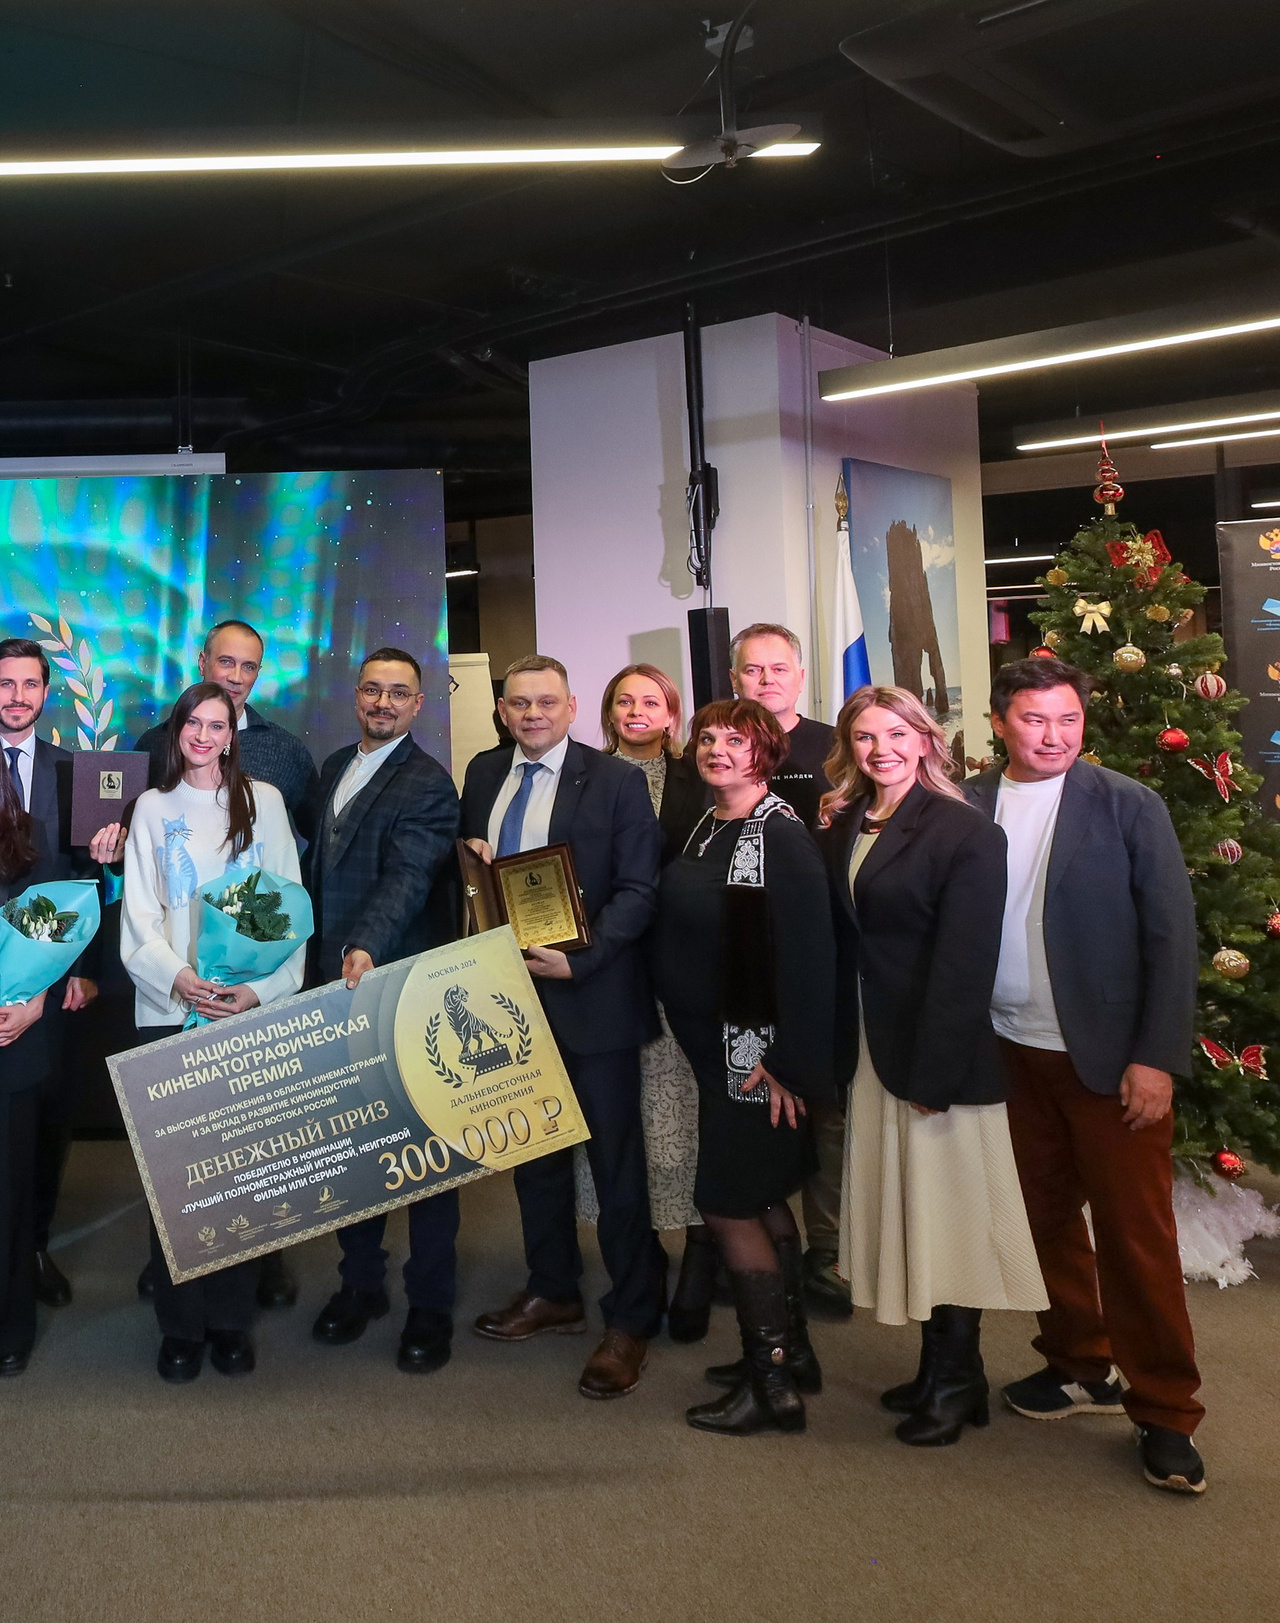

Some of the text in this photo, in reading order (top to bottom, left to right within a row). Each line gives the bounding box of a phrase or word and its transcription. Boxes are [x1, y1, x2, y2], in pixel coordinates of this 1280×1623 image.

[427, 958, 477, 980] МОСКВА 2024
[147, 1014, 370, 1101] КИНЕМАТОГРАФИЧЕСКАЯ
[181, 1009, 325, 1069] НАЦИОНАЛЬНАЯ
[154, 1053, 387, 1138] ЗА ВЫСОКИЕ ДОСТИЖЕНИЯ В ОБЛАСТИ КИНЕМАТОГРАФИИ
[228, 1057, 303, 1095] ПРЕМИЯ
[450, 1069, 542, 1109] ДАЛЬНЕВОСТОЧНАЯ
[469, 1085, 534, 1115] КИНОПРЕМИЯ
[191, 1075, 361, 1138] И ЗА ВКЛАД В РАЗВИТИЕ КИНОИНДУСТРИИ
[221, 1095, 338, 1142] ДАЛЬНЕГО ВОСТОКА РОССИИ
[181, 1127, 411, 1214] «ЛУЧШИЙ ПОЛНОМЕТРАЖНЫЙ ИГРОВОЙ, НЕИГРОВОЙ
[185, 1100, 390, 1190] ДЕНЕЖНЫЙ ПРИЗ
[233, 1137, 353, 1184] ПОБЕДИТЕЛЮ В НОМИНАЦИИ
[378, 1135, 451, 1191] 300
[460, 1107, 531, 1161] 000
[253, 1164, 348, 1203] ФИЛЬМ ИЛИ СЕРИАЛ»
